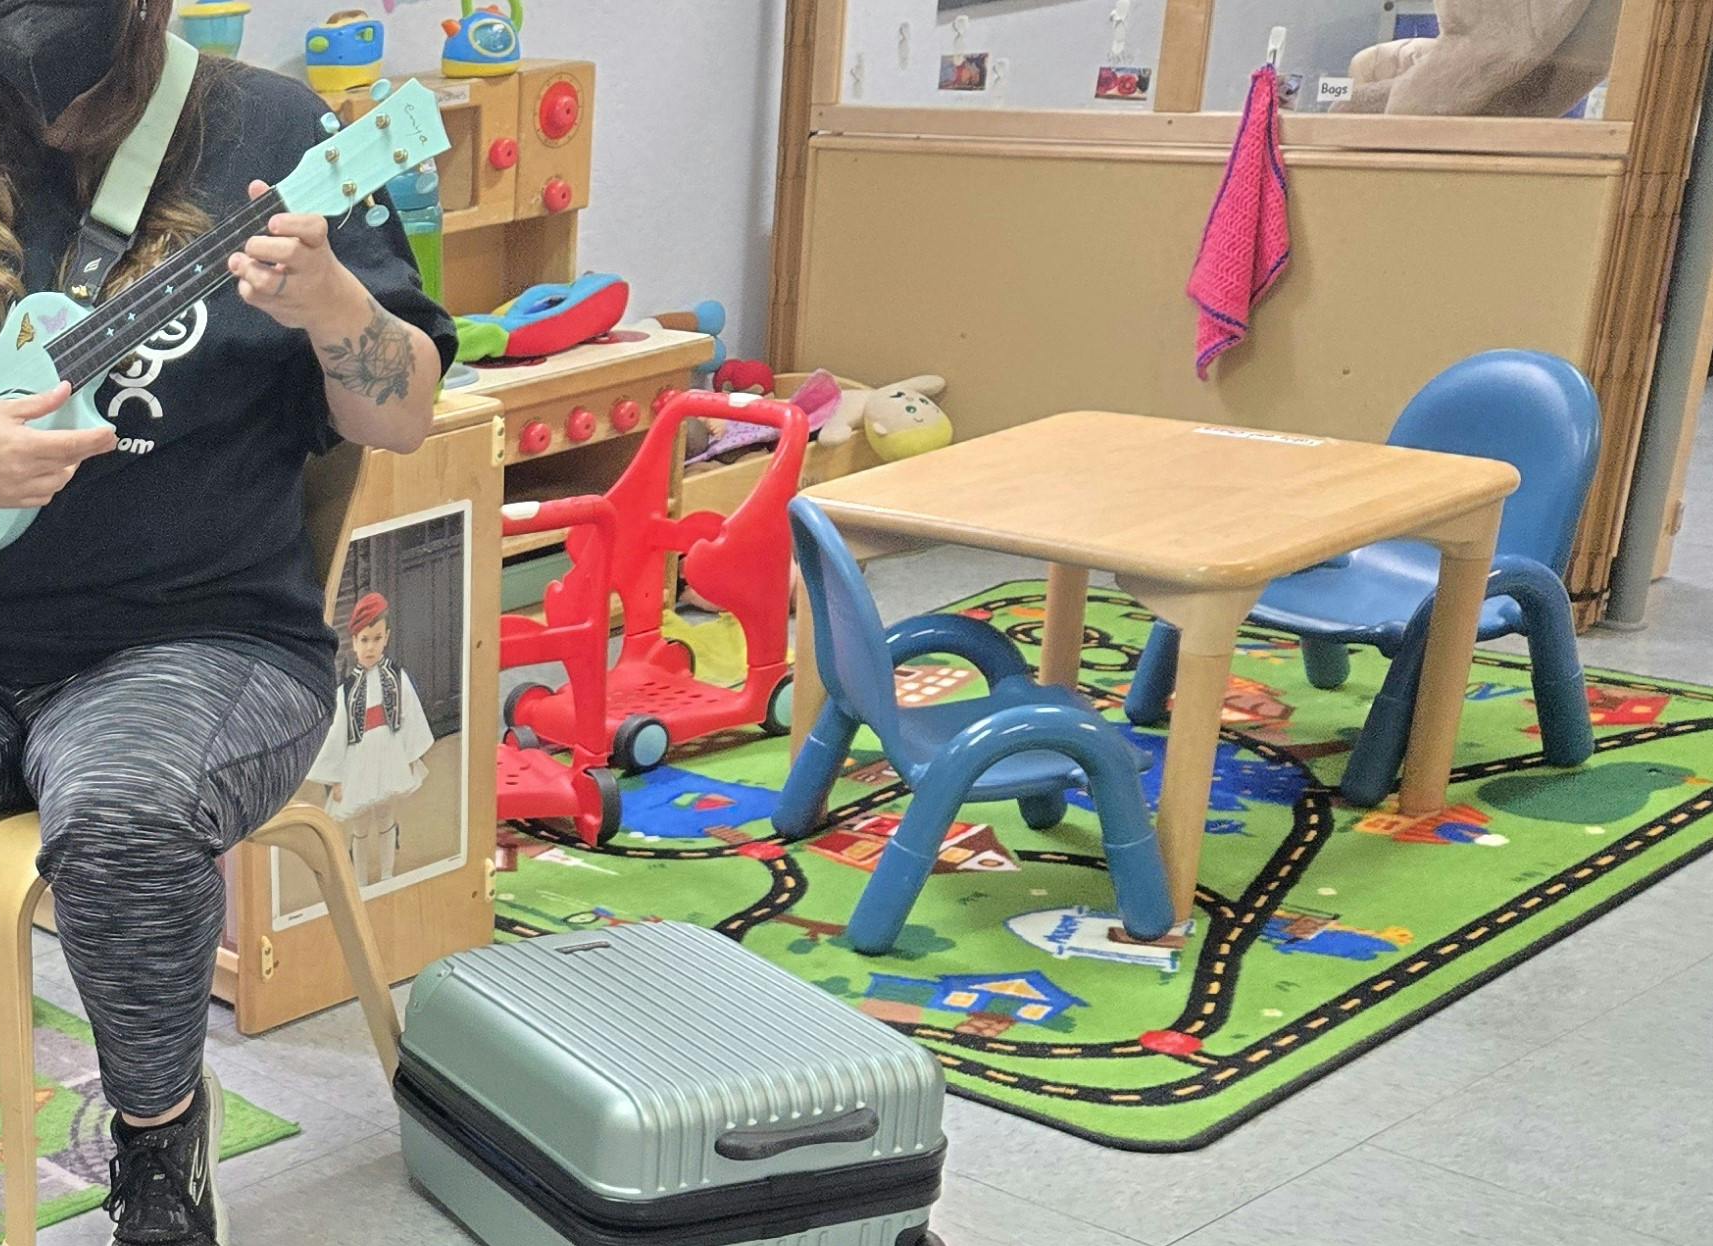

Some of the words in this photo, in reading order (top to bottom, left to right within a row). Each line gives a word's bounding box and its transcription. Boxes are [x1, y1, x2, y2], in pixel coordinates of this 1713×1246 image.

[1321, 82, 1348, 97] Bags
[404, 103, 428, 147] enya
[117, 437, 155, 455] om
